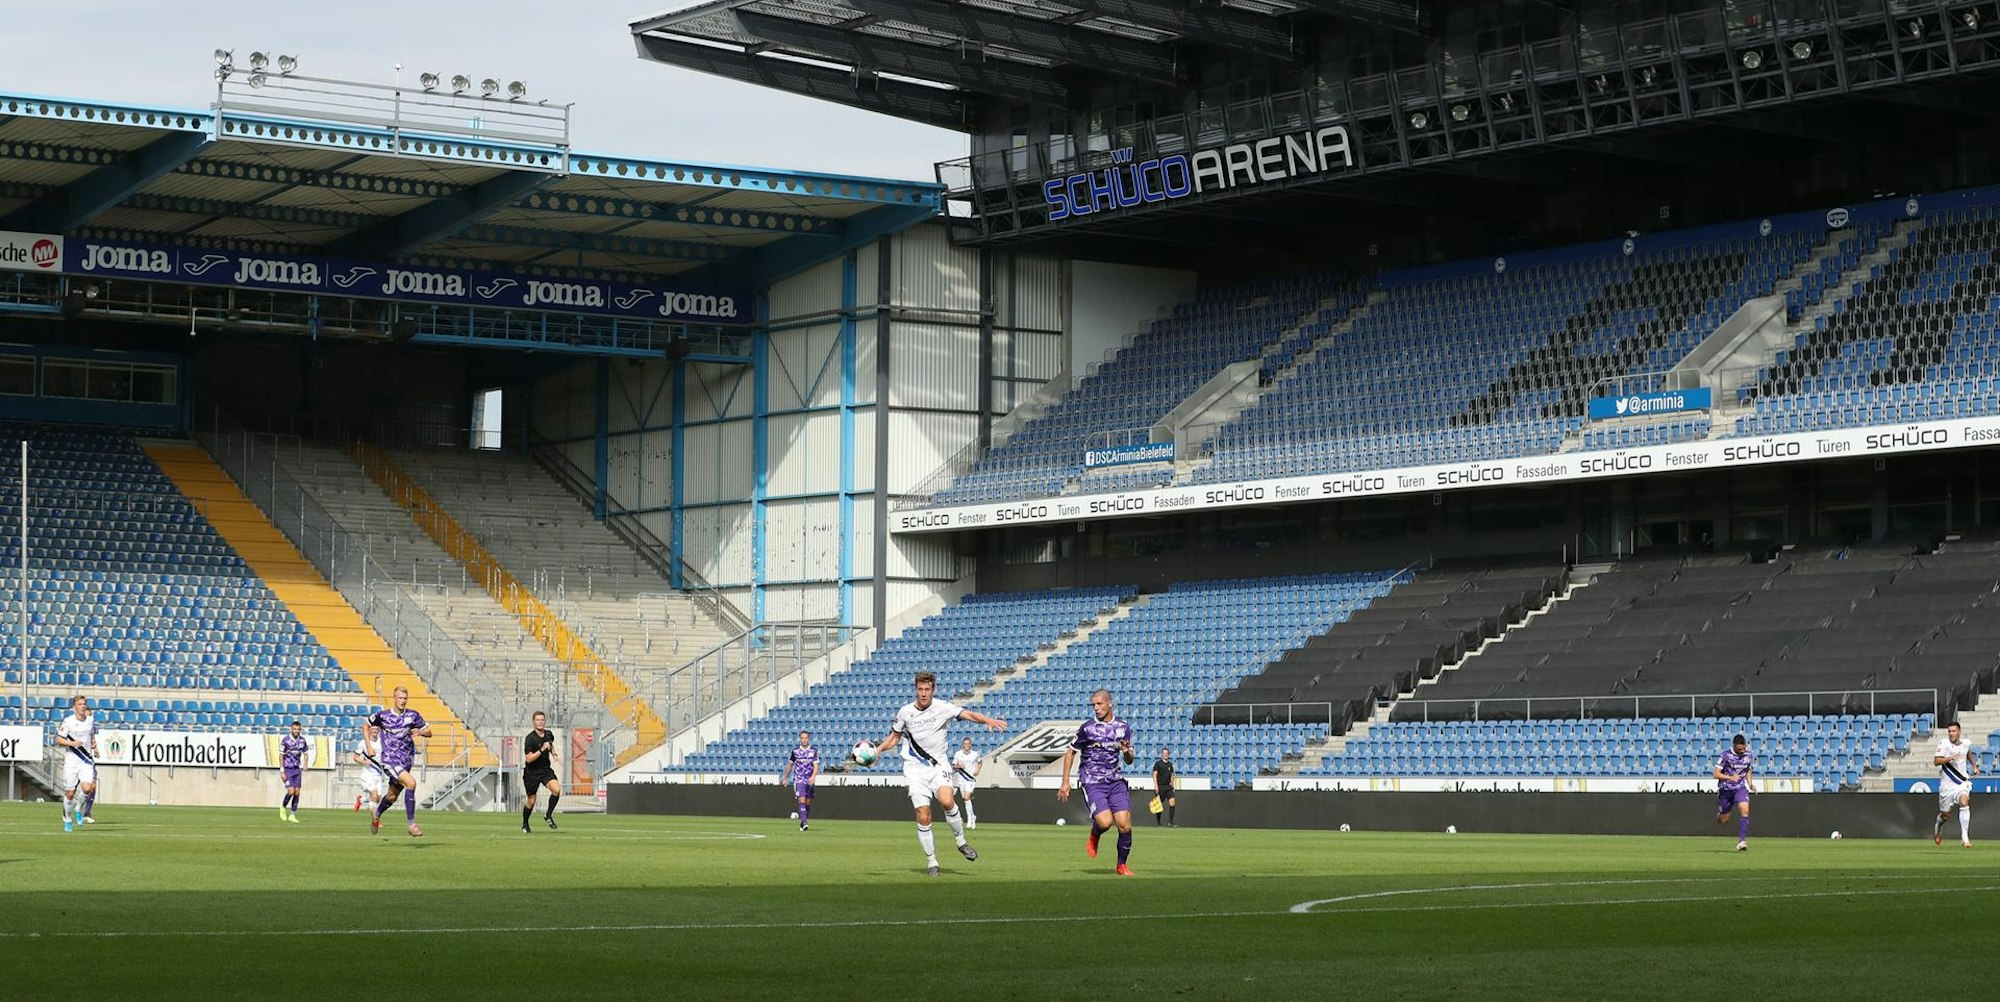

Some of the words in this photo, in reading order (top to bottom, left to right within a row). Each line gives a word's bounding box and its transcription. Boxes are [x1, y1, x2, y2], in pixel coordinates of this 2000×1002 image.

[0, 242, 27, 263] che
[1628, 391, 1684, 413] @arminia
[1095, 443, 1174, 465] DSCArminiaBielefeld
[902, 511, 950, 529] SCHÜCO
[958, 511, 987, 525] Fenster
[996, 503, 1047, 521] SCHÜCO
[1057, 503, 1080, 517] Türen
[1090, 495, 1144, 513] SCHÜCO
[1154, 494, 1195, 508] Fassaden
[1206, 484, 1264, 503] SCHÜCO
[1275, 484, 1310, 498] Fenster
[1322, 474, 1385, 494] SCHÜCO
[1397, 474, 1425, 488] Türen
[1437, 464, 1504, 485] SCHÜCO
[1516, 463, 1567, 478] Fassaden
[1580, 451, 1652, 474] SCHÜCO
[1665, 450, 1709, 466] Fenster
[1723, 438, 1800, 461] SCHÜCO
[1816, 438, 1851, 454] Türen
[1866, 426, 1948, 450] SCHÜCO
[131, 734, 247, 765] Krombacher
